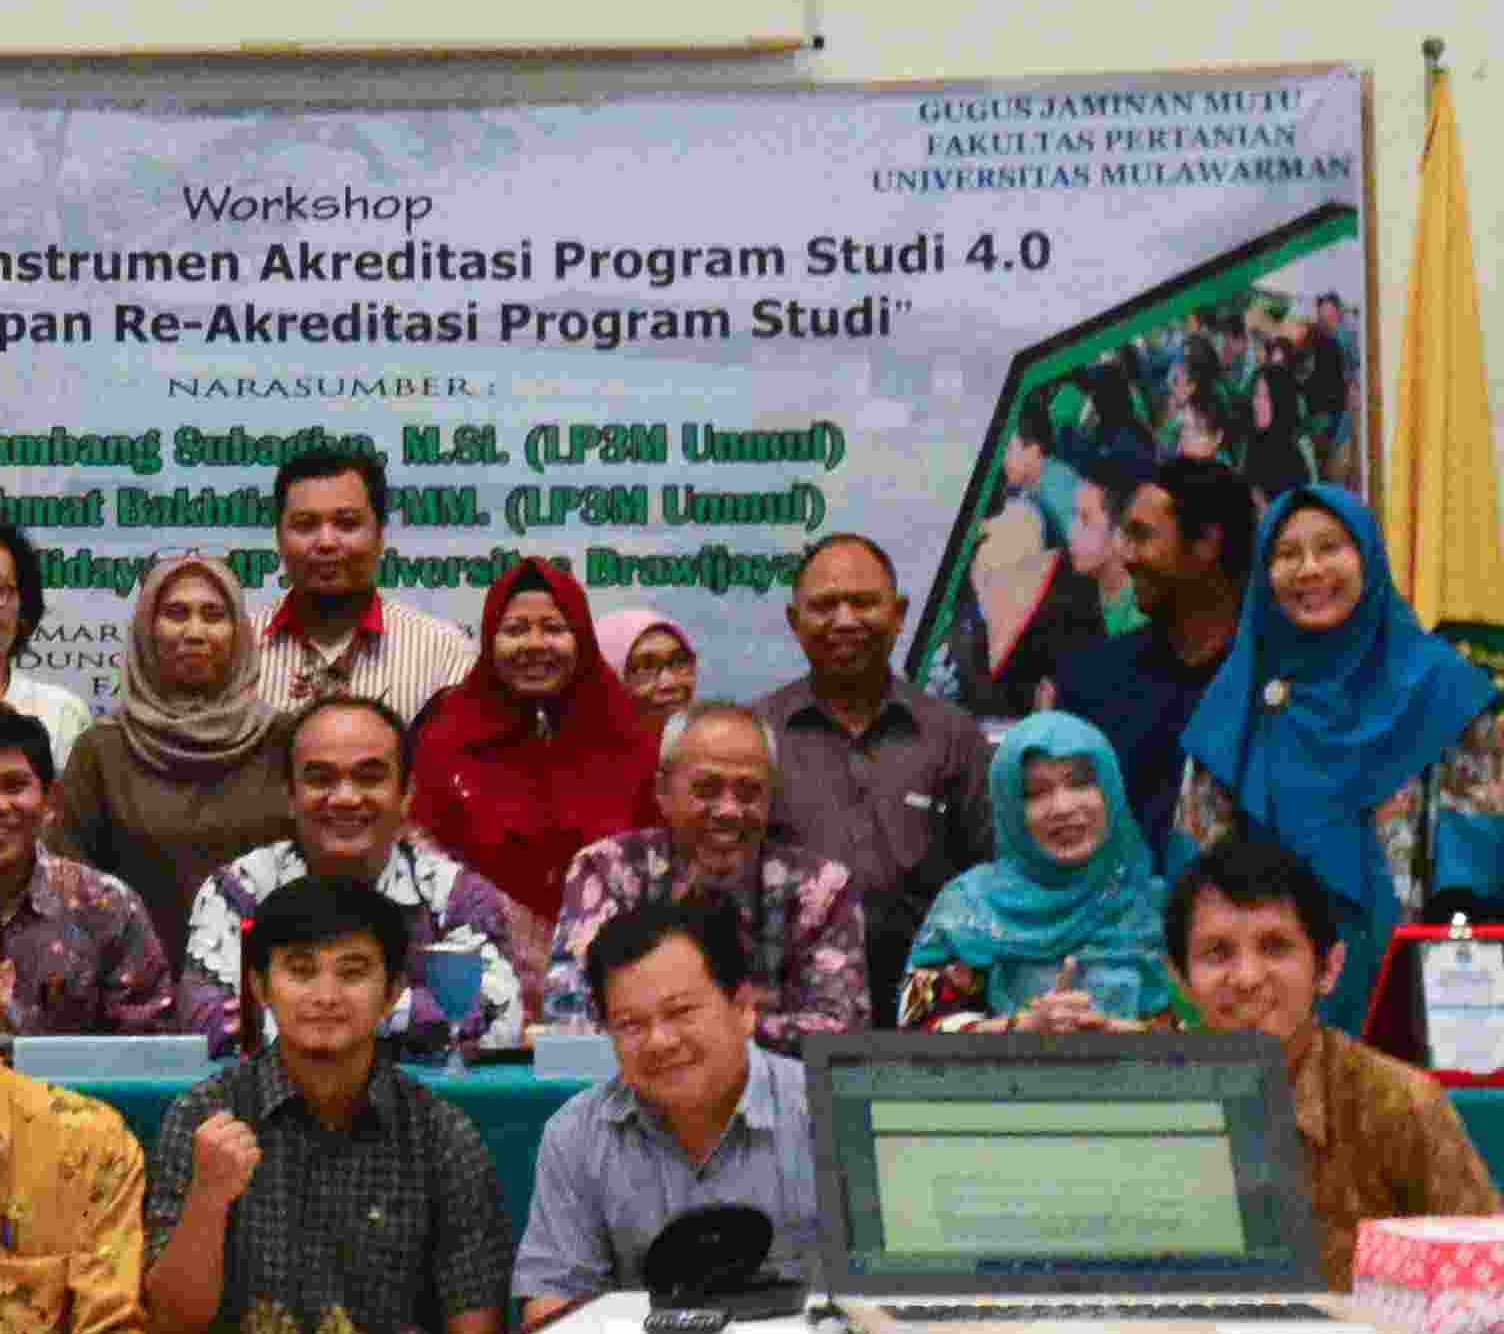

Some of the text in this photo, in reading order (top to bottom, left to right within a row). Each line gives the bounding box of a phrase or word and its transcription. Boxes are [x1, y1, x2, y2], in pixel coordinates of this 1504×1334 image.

[919, 87, 1302, 124] GUGUS JAMINAN MUTU
[927, 124, 1296, 156] FAKULTAS PERTANIAN
[872, 154, 1352, 193] UNIVERSITAS MULAWARMAN
[182, 185, 433, 234] Workshop
[260, 240, 533, 282] Akreditasi
[554, 240, 786, 288] Program
[806, 234, 945, 275] Studi
[965, 230, 1052, 272] 4.0
[113, 302, 479, 344] Re-Akreditasi
[499, 301, 731, 349] Program
[167, 376, 473, 399] NARASUMBER
[524, 423, 668, 473] (LP3M
[116, 486, 278, 527] Bakhtia
[505, 485, 649, 536] (LP3M
